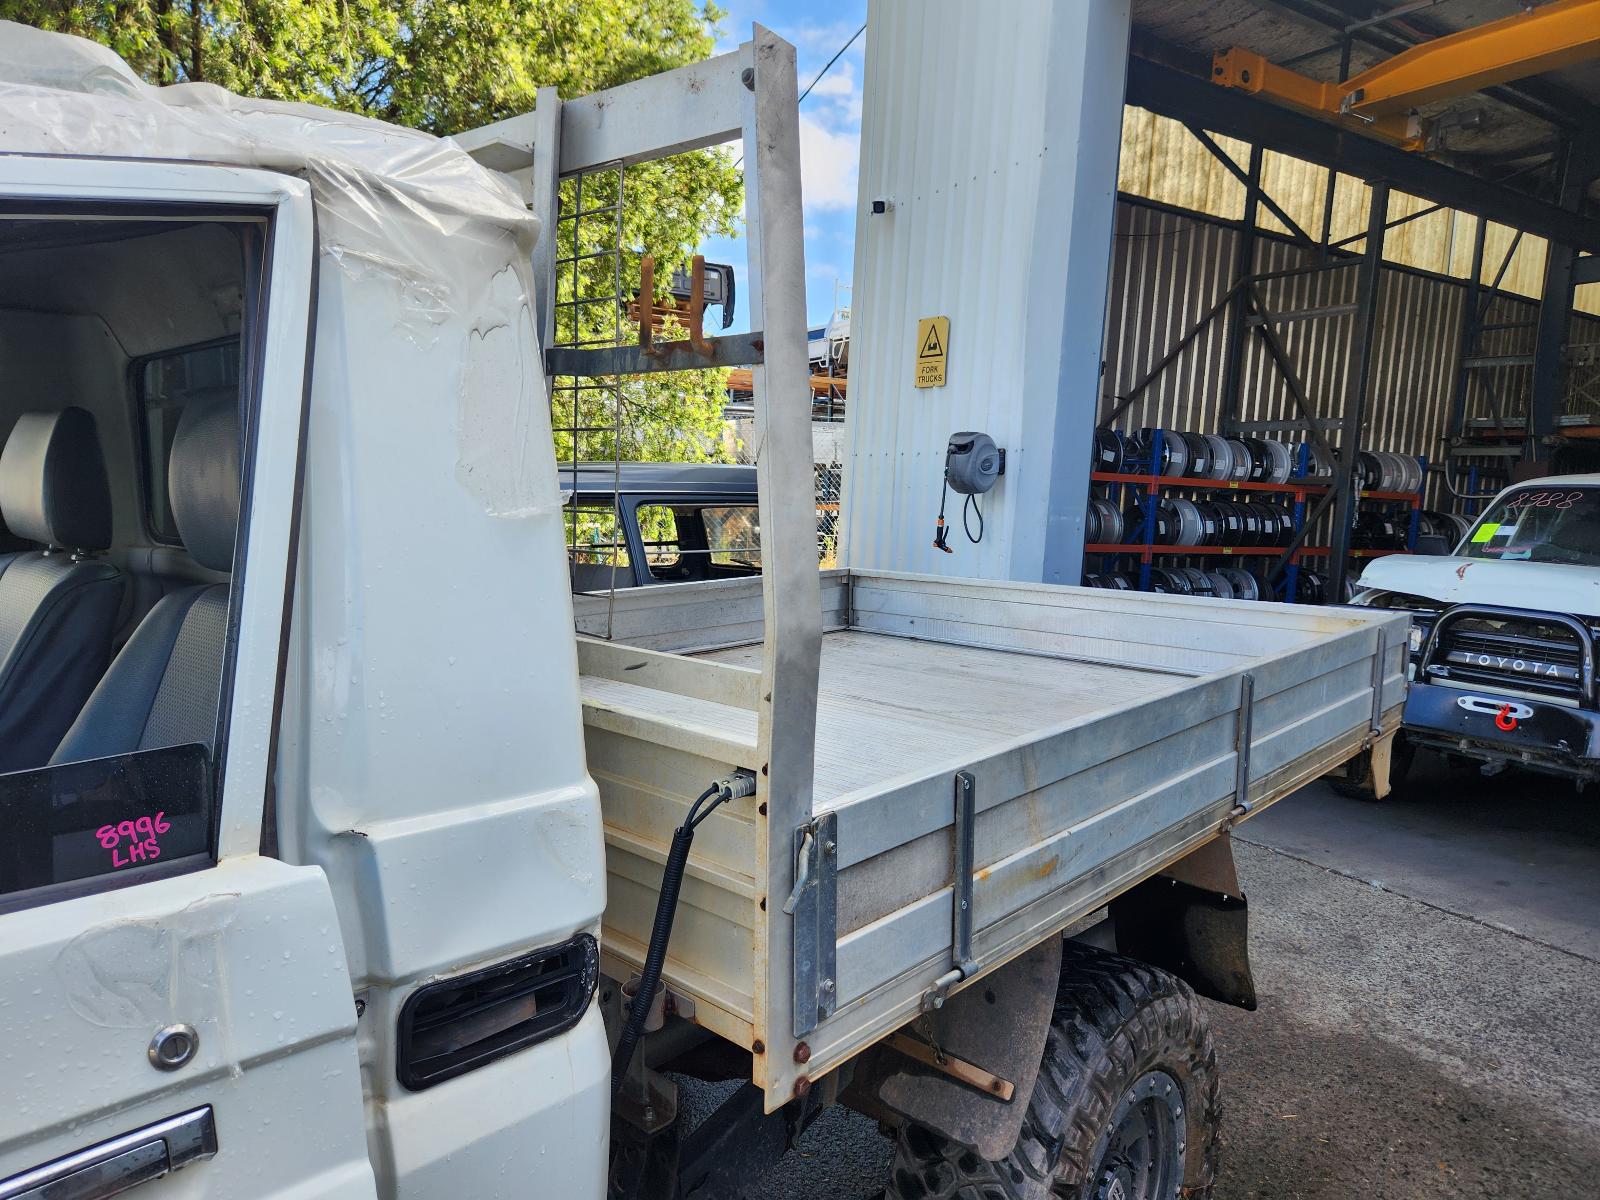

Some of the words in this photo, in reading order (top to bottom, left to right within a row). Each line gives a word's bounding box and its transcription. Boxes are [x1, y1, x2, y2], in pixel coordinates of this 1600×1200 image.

[918, 374, 943, 384] TRUCKS
[921, 365, 939, 375] FORK
[1463, 652, 1559, 677] TOYOTA
[95, 811, 171, 849] 8996
[112, 838, 161, 868] LHS
